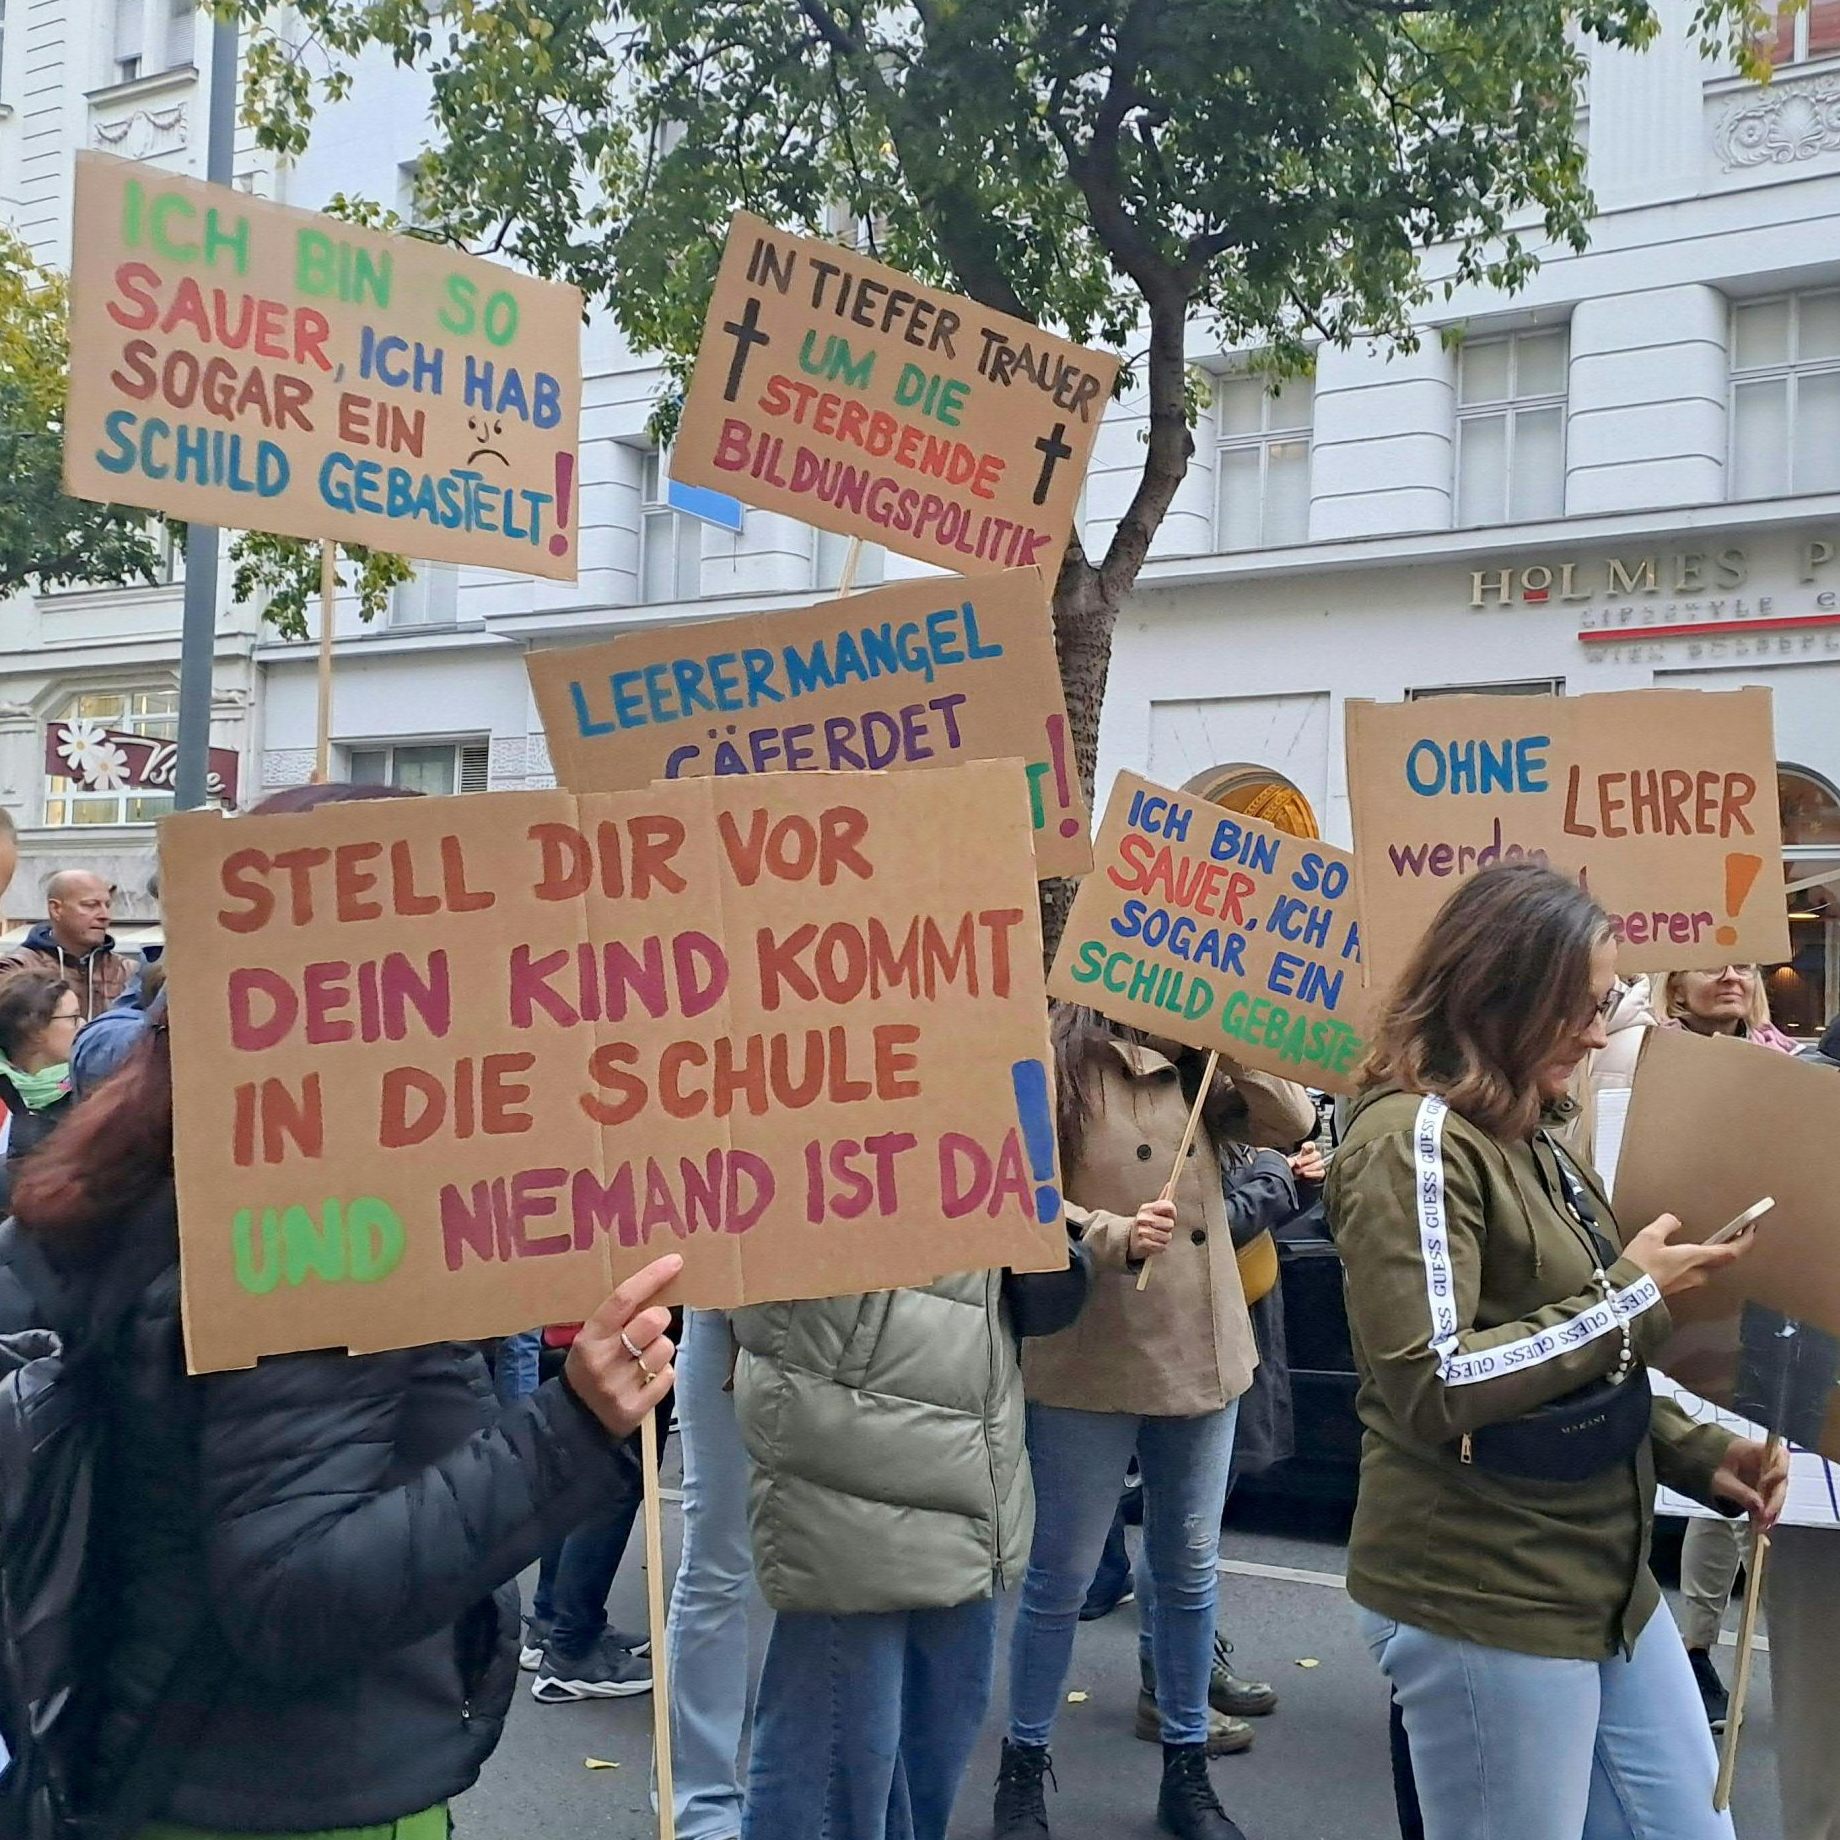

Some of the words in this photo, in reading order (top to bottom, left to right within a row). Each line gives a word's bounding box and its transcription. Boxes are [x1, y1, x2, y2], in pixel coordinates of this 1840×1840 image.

[121, 179, 250, 276] ICH
[295, 227, 393, 309] BIN
[436, 272, 520, 347] SO
[106, 261, 346, 384] SAUER,
[360, 326, 444, 395] ICH
[464, 355, 563, 429] HAB
[746, 238, 797, 294] IN
[809, 257, 961, 360] TIEFER
[978, 327, 1101, 423] TRAUER
[799, 328, 877, 390] UM
[894, 362, 971, 427] DIE
[110, 338, 314, 433] SOGAR
[338, 391, 425, 458] EIN
[758, 374, 1006, 500] STERBENDE
[96, 410, 290, 498] SCHILD
[319, 451, 574, 557] GEBASTELT!
[713, 418, 1052, 567] BILDUNGSPOLITIK
[1469, 549, 1748, 607] HOLMES
[569, 601, 1003, 739] LEERERMANGEL
[1127, 790, 1192, 843] ICH
[1210, 819, 1280, 876] BIN
[1292, 852, 1349, 899] SO
[1406, 735, 1551, 797] OHNE
[1562, 764, 1756, 838] LEHRER
[219, 833, 495, 934] STELL
[528, 815, 686, 902] DIR
[717, 805, 873, 886] VOR
[1107, 834, 1257, 928] SAUER,
[1267, 893, 1333, 949] ICH
[228, 947, 450, 1052] DEIN
[510, 929, 730, 1028] KIND
[756, 908, 1023, 1011] KOMMT
[1070, 940, 1213, 1022] SCHILD
[1221, 992, 1363, 1076] GEBASTE
[1110, 899, 1245, 978] SOGAR
[1268, 955, 1344, 1011] EIN
[234, 1070, 323, 1166] IN
[378, 1051, 535, 1148] DIE
[579, 1022, 922, 1126] SCHULE
[1420, 1119, 1435, 1164] GUESS
[231, 1195, 406, 1294] UND
[440, 1147, 775, 1271] NIEMAND
[805, 1130, 917, 1224] IST
[938, 1058, 1060, 1225] DA!
[1424, 1171, 1440, 1229] GUESS
[1428, 1239, 1447, 1297] GUESS
[1559, 1312, 1608, 1346] GUESS
[1503, 1336, 1555, 1367] GUESS
